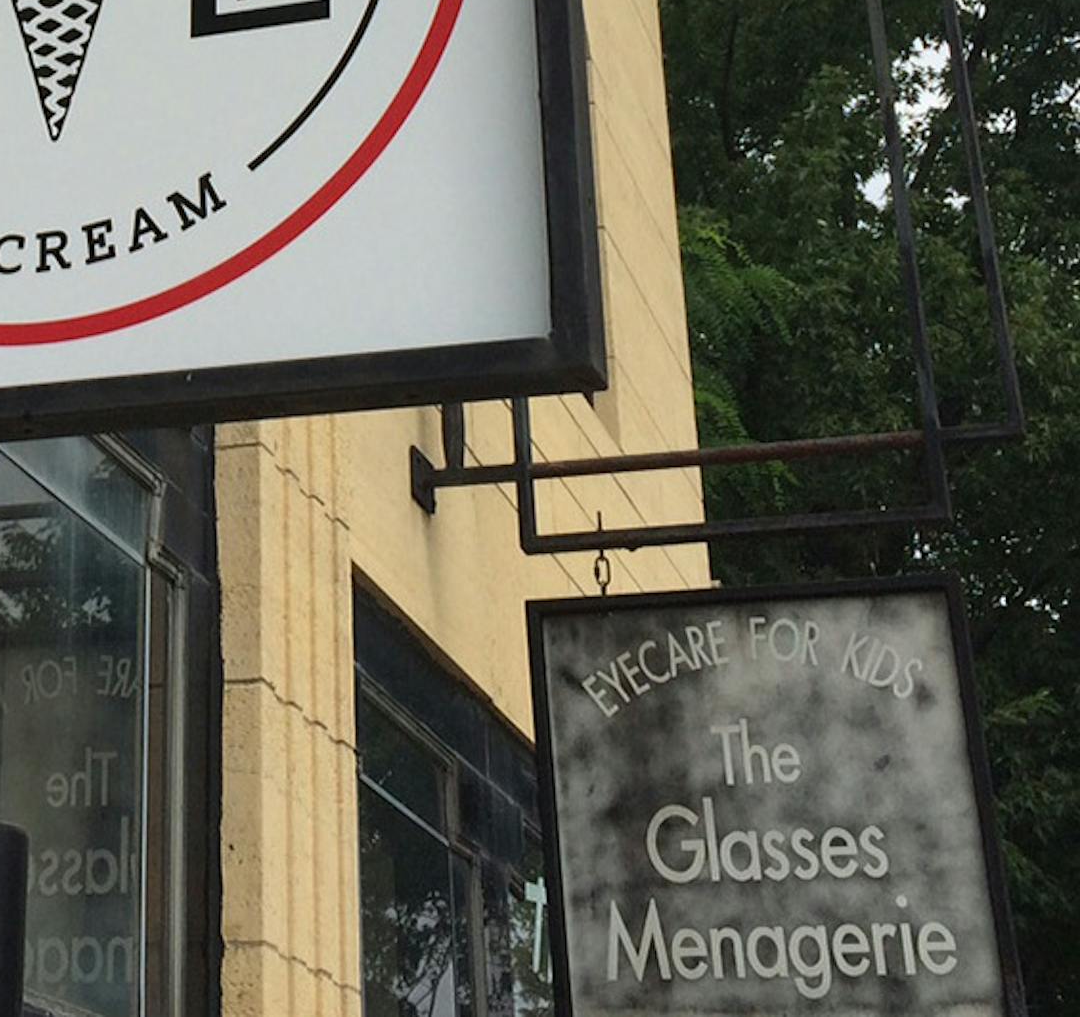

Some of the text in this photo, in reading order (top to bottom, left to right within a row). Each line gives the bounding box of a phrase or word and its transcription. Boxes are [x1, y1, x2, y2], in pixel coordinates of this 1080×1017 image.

[581, 616, 923, 718] EYECARE FOR KIDS
[710, 717, 802, 786] The
[645, 796, 891, 884] Glasses
[606, 894, 958, 999] Menagerie
